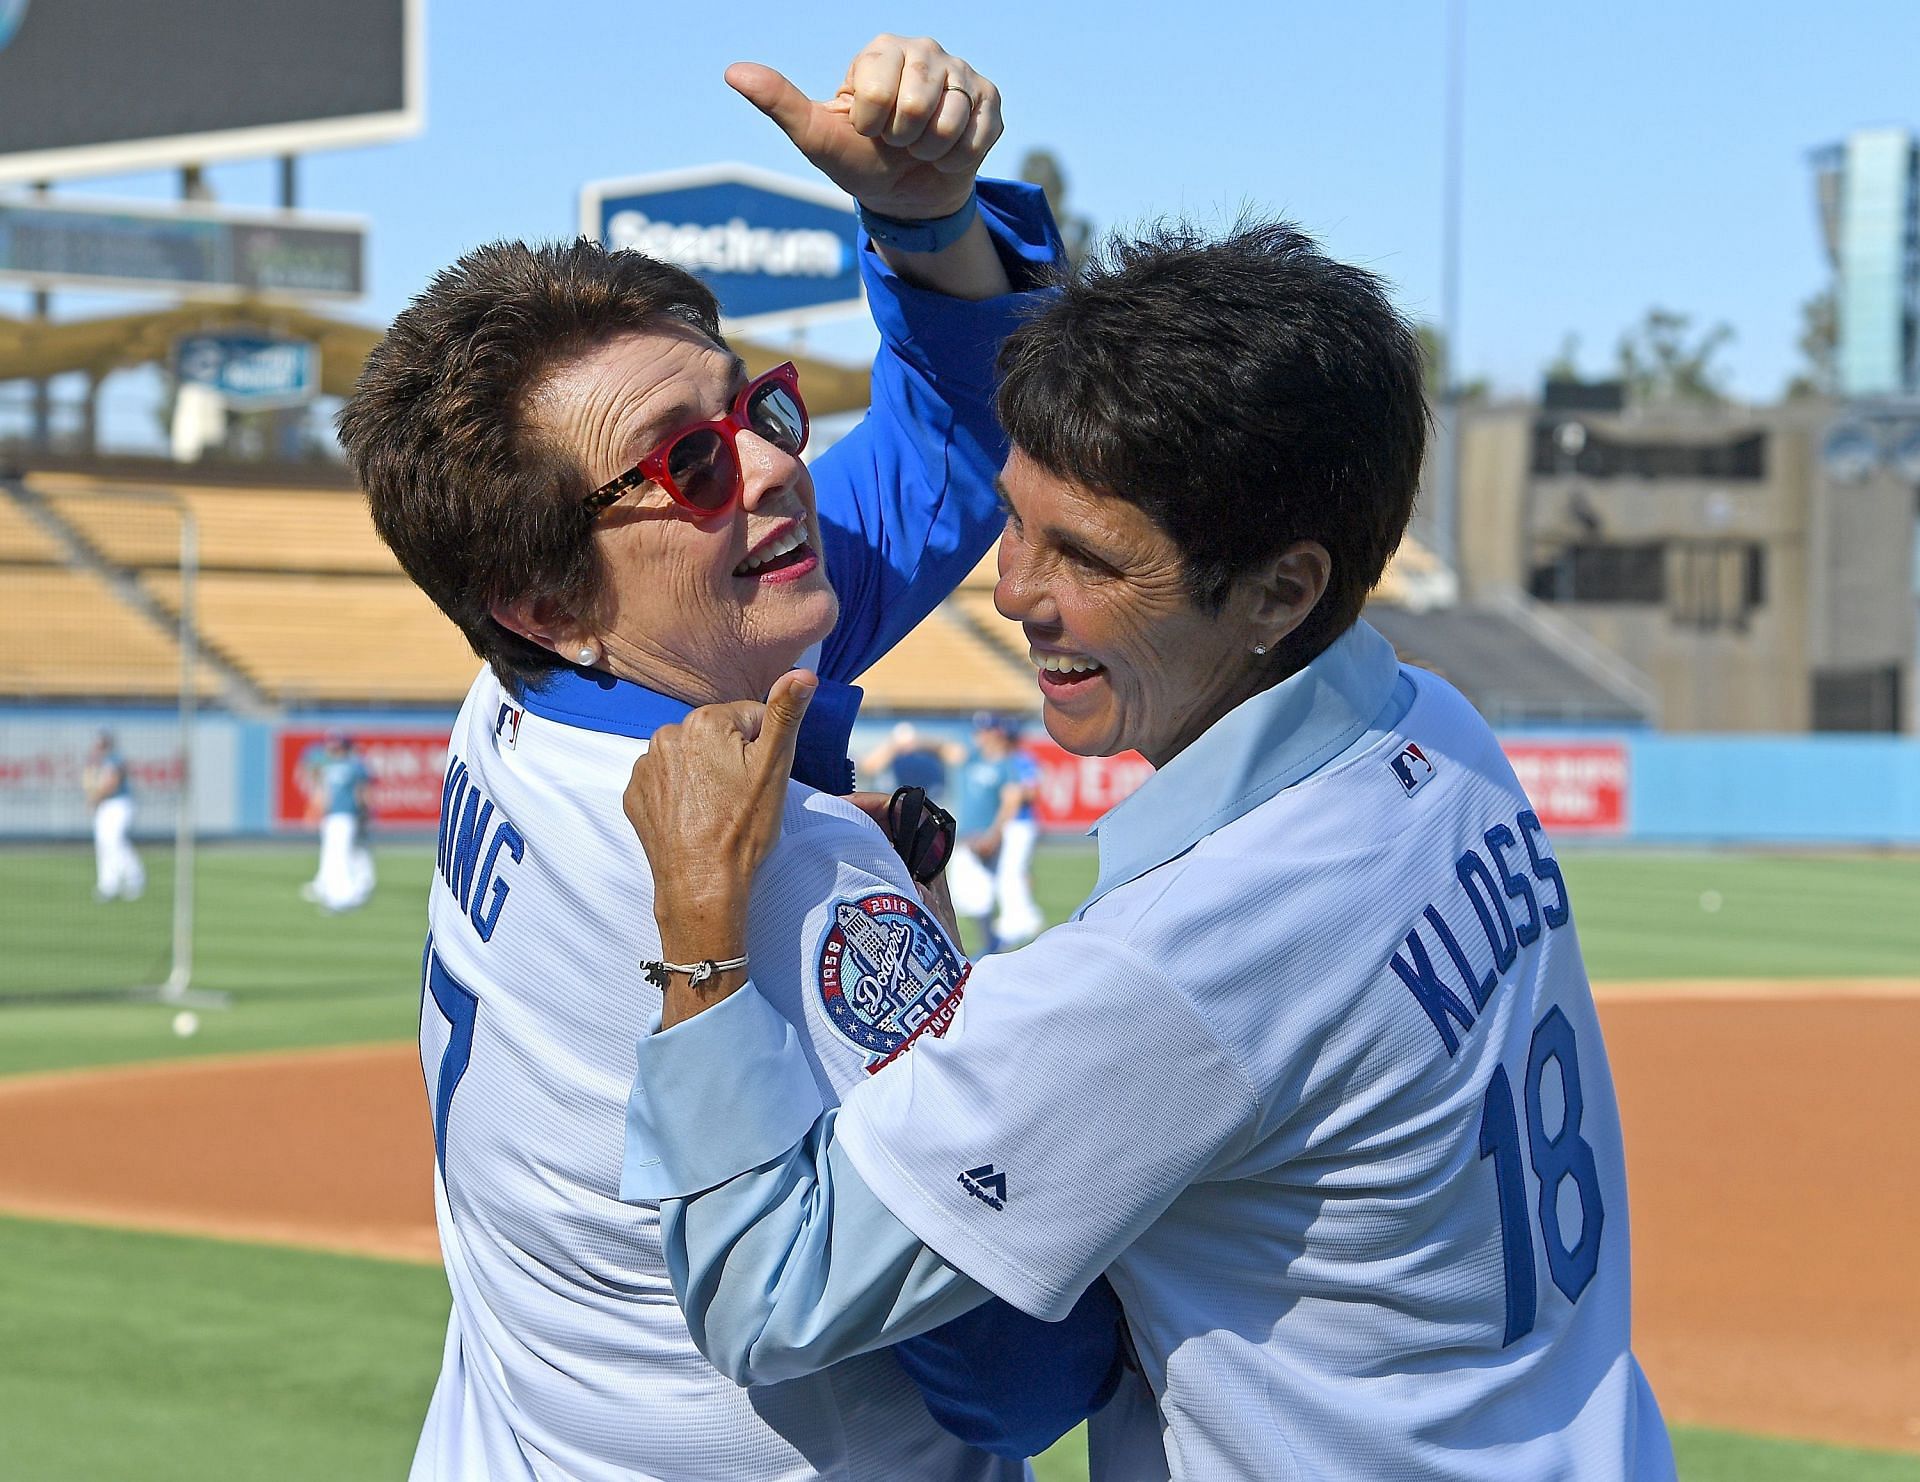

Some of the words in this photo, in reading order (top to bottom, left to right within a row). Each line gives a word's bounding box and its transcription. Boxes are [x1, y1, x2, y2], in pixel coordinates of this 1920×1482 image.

[438, 754, 525, 943] KING
[870, 898, 909, 914] 2018
[823, 941, 842, 987] 1958
[854, 921, 911, 1014] Dodgers
[1389, 809, 1569, 1058] KLOSS
[1479, 1003, 1605, 1349] 18
